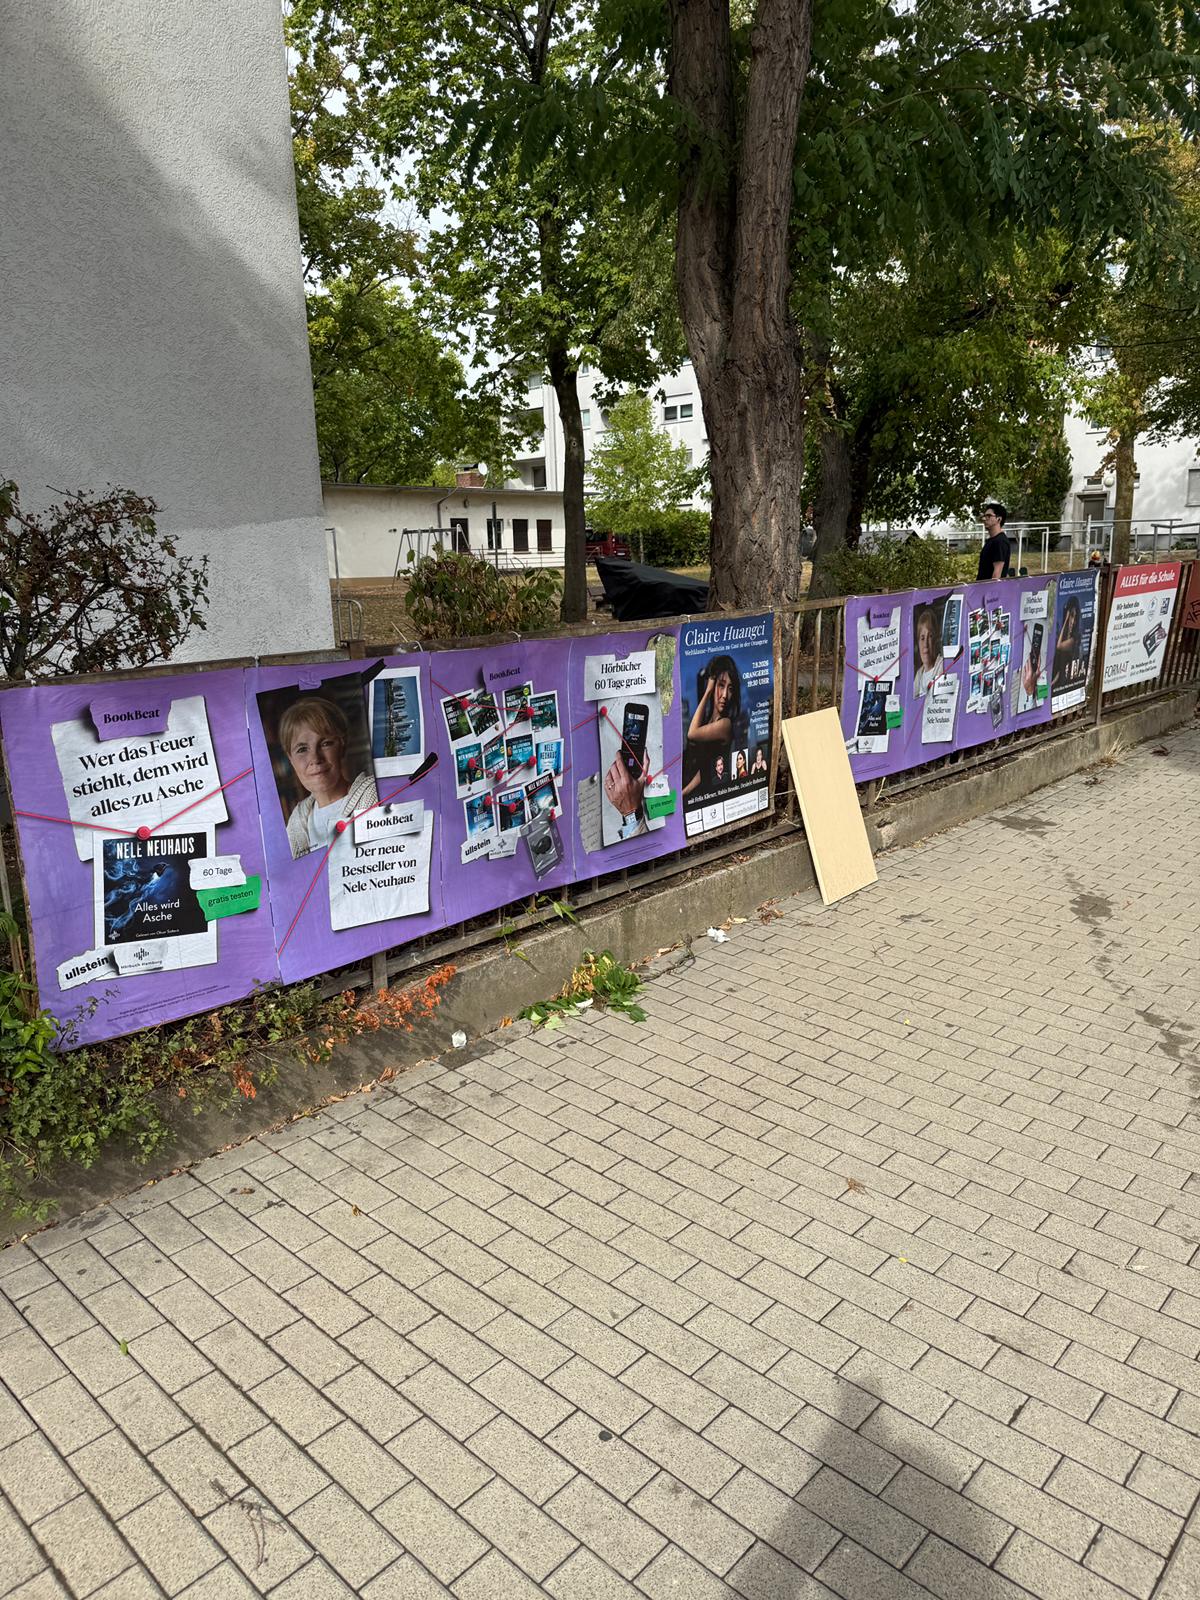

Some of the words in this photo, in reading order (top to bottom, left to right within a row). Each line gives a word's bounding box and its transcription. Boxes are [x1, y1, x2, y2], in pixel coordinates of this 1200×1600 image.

[1120, 574, 1139, 588] ALLES
[1139, 574, 1148, 585] für
[1149, 572, 1157, 584] die
[1159, 570, 1175, 582] Schule
[685, 628, 720, 646] Claire
[723, 621, 765, 641] Huangci
[601, 662, 641, 674] Hörbücher
[594, 679, 606, 690] 60
[608, 679, 624, 690] Tage
[625, 674, 646, 688] gratis
[104, 709, 160, 723] BookBeat
[79, 753, 115, 771] Wer
[119, 747, 148, 763] das
[150, 736, 195, 755] Feuer
[72, 773, 131, 798] stiehlt,
[133, 764, 170, 782] dem
[171, 752, 209, 773] wird
[90, 798, 130, 817] alles
[133, 792, 153, 807] zu
[156, 779, 204, 800] Asche
[366, 814, 413, 830] BookBeat
[116, 841, 142, 860] NELE
[148, 837, 195, 857] NEUHAUS
[355, 847, 376, 858] Der
[378, 844, 405, 856] neue
[465, 838, 491, 855] ullstein
[203, 868, 214, 877] 60
[215, 867, 232, 876] Tage
[342, 860, 396, 877] Bestseller
[394, 859, 416, 868] von
[342, 882, 367, 895] Nele
[369, 874, 416, 890] Neuhaus
[135, 901, 158, 912] Alles
[161, 899, 180, 909] wird
[207, 896, 229, 907] gratis
[230, 890, 254, 901] testen
[143, 912, 172, 924] Asche
[65, 955, 109, 980] ullstein
